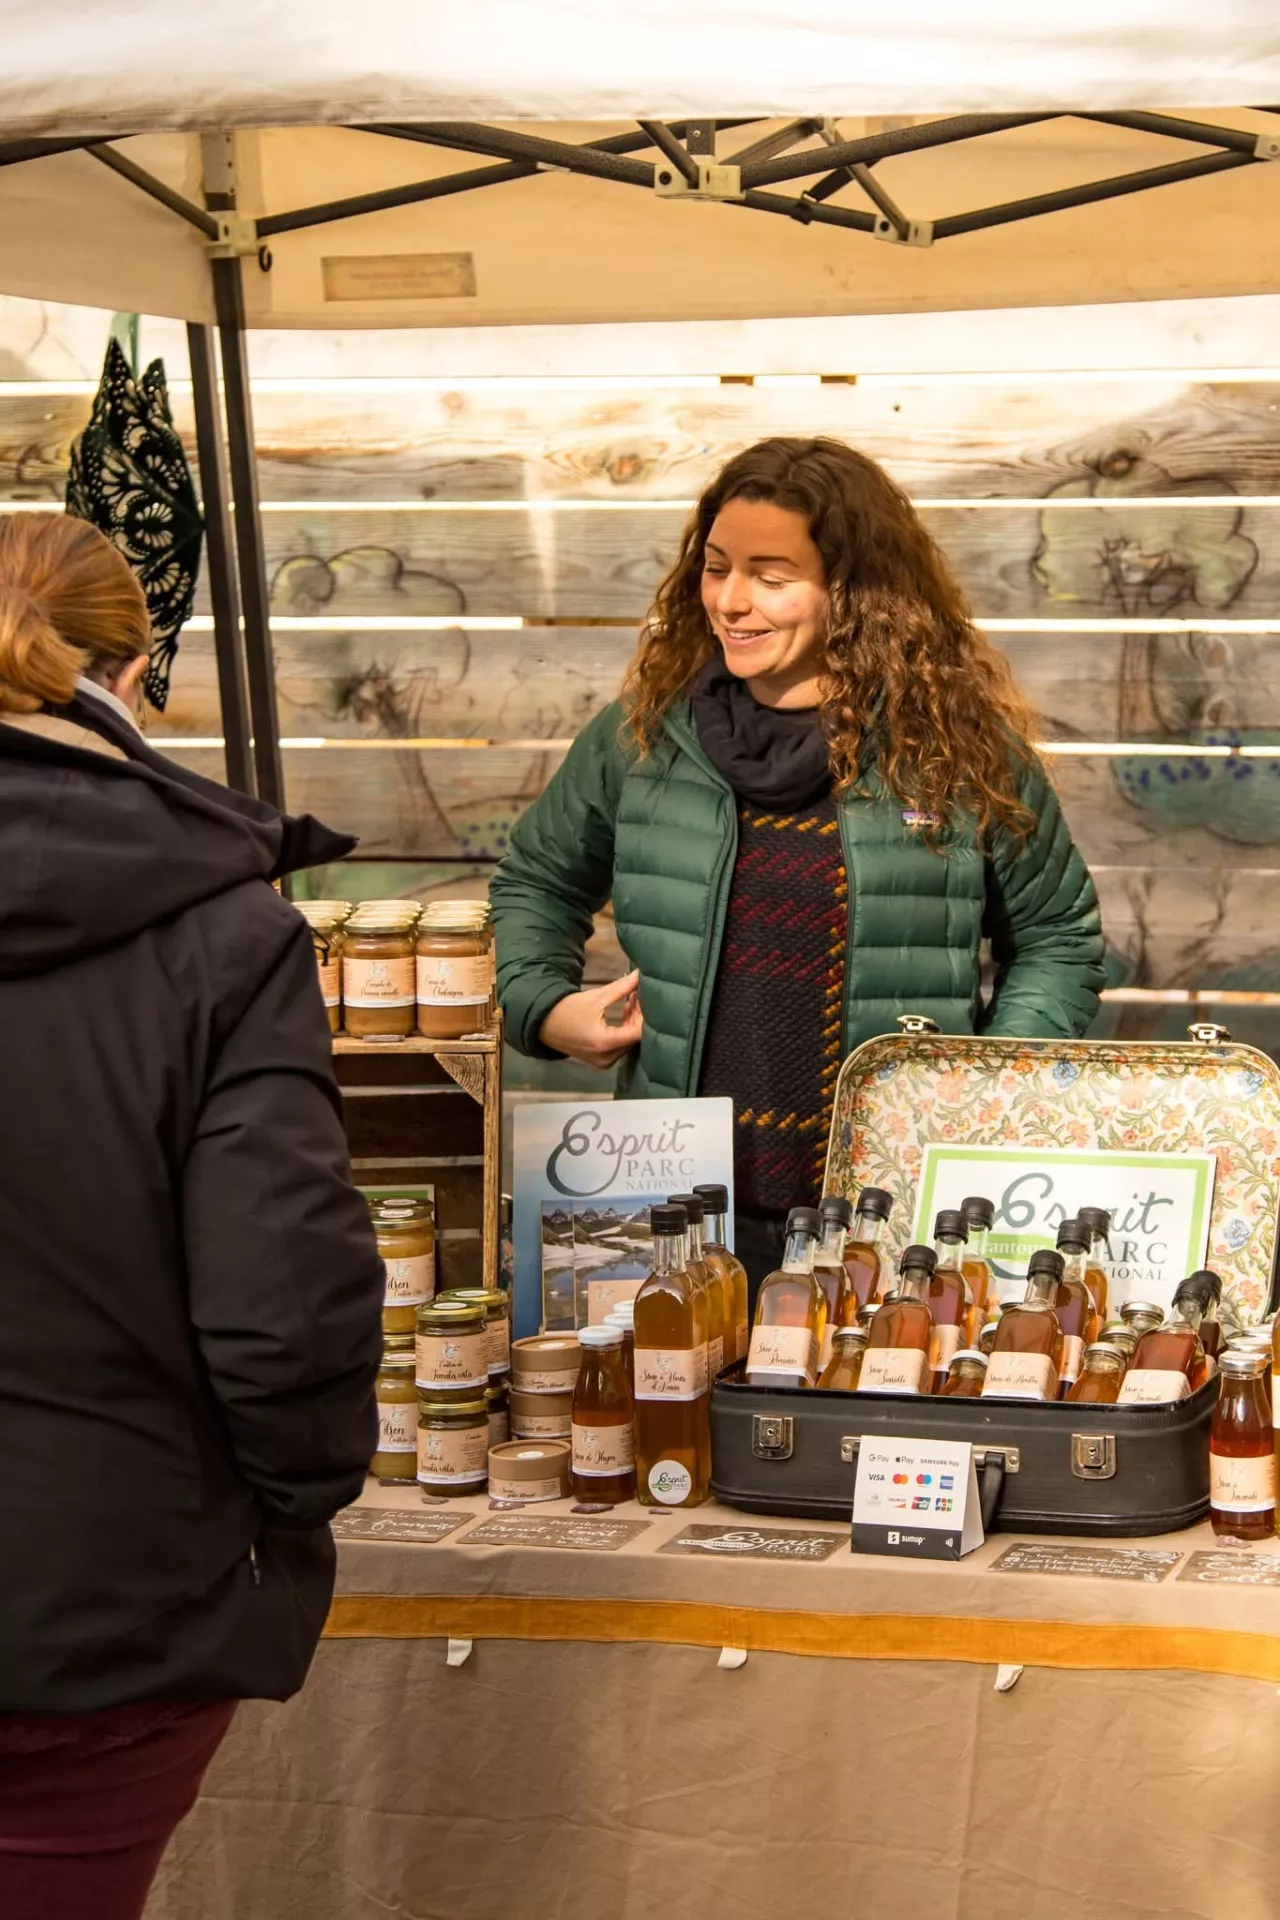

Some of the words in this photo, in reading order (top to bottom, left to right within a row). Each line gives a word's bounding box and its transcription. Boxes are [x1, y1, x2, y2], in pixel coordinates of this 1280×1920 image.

[546, 1110, 695, 1197] Esprit
[626, 1158, 695, 1177] PARC
[625, 1179, 694, 1191] NATIONAL
[1104, 1240, 1168, 1264] ARC
[1103, 1267, 1167, 1281] TIONAL
[877, 1454, 890, 1463] Pay
[868, 1473, 886, 1482] VISA
[703, 1532, 835, 1551] Esprit
[901, 1536, 922, 1545] sumup
